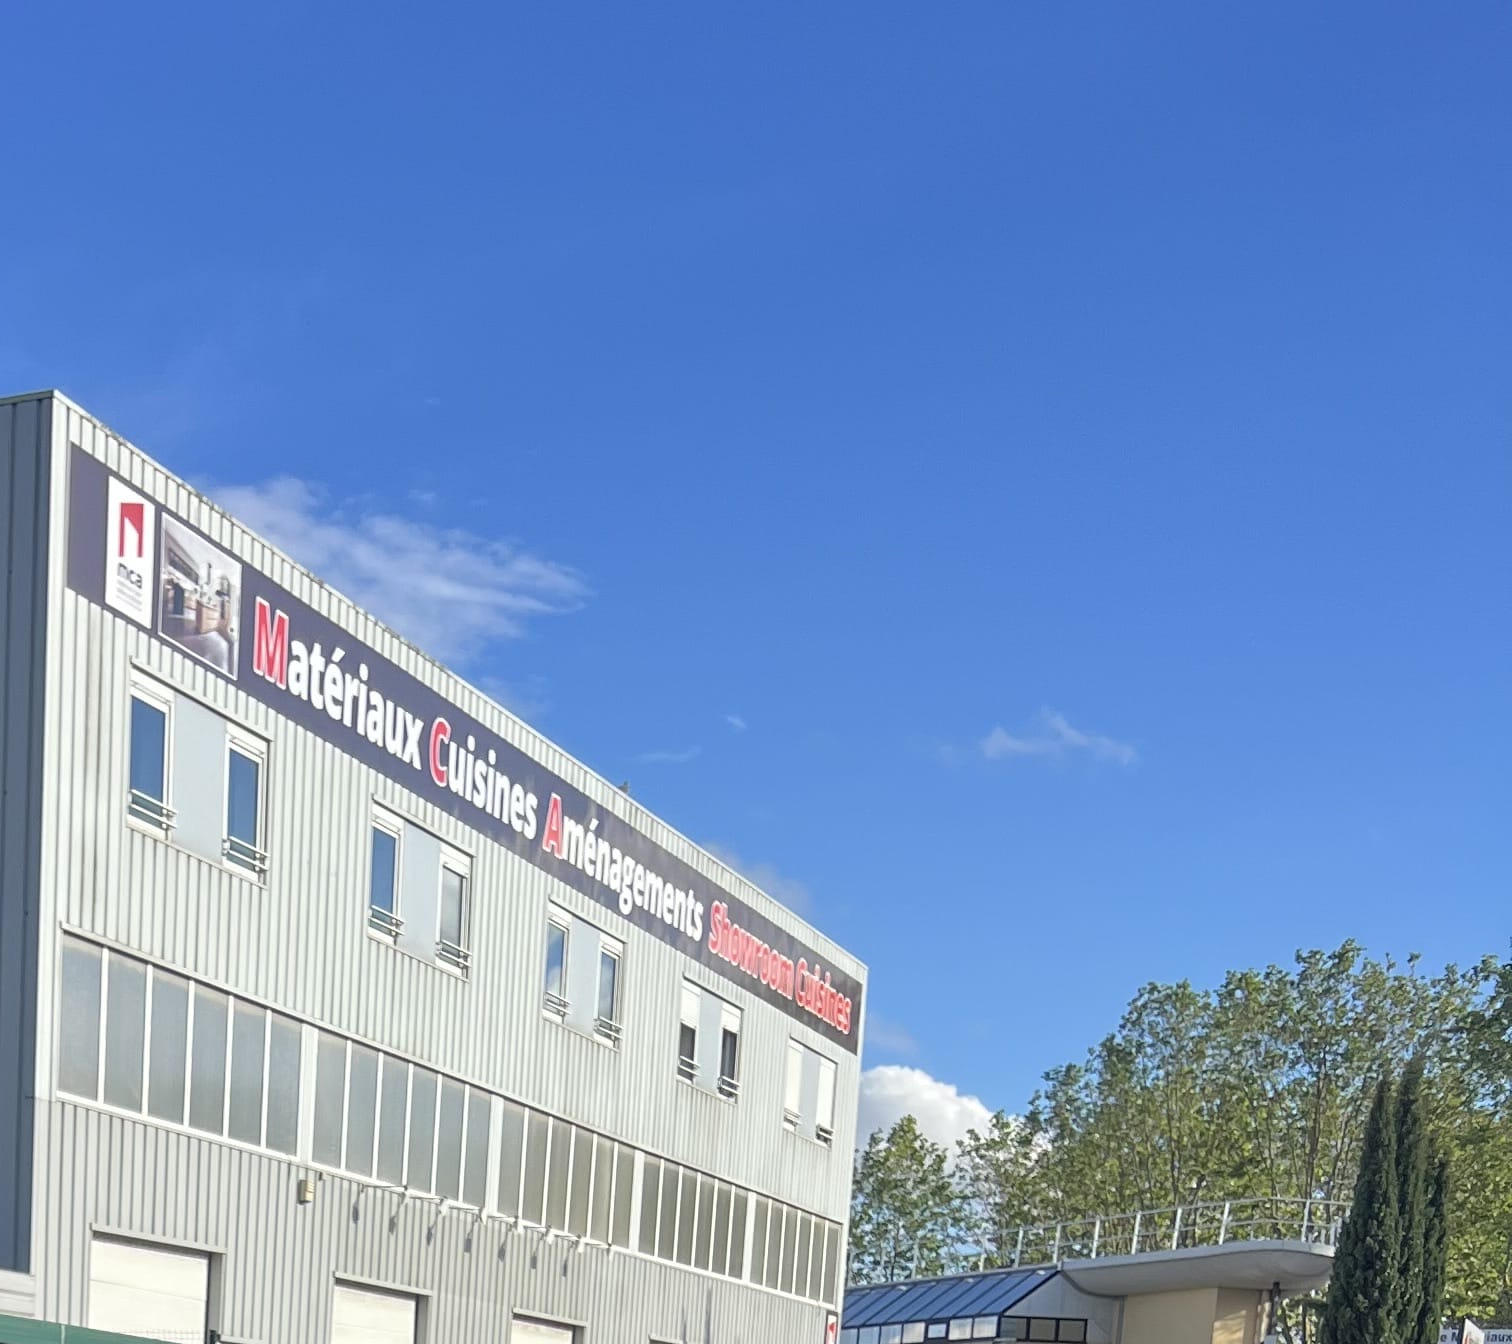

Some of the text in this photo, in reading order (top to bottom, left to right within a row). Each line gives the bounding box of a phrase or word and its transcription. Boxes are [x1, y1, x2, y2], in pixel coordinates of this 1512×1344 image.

[253, 595, 852, 1035] Matériaux Cuisines Aménagements Showroom Cuisines
